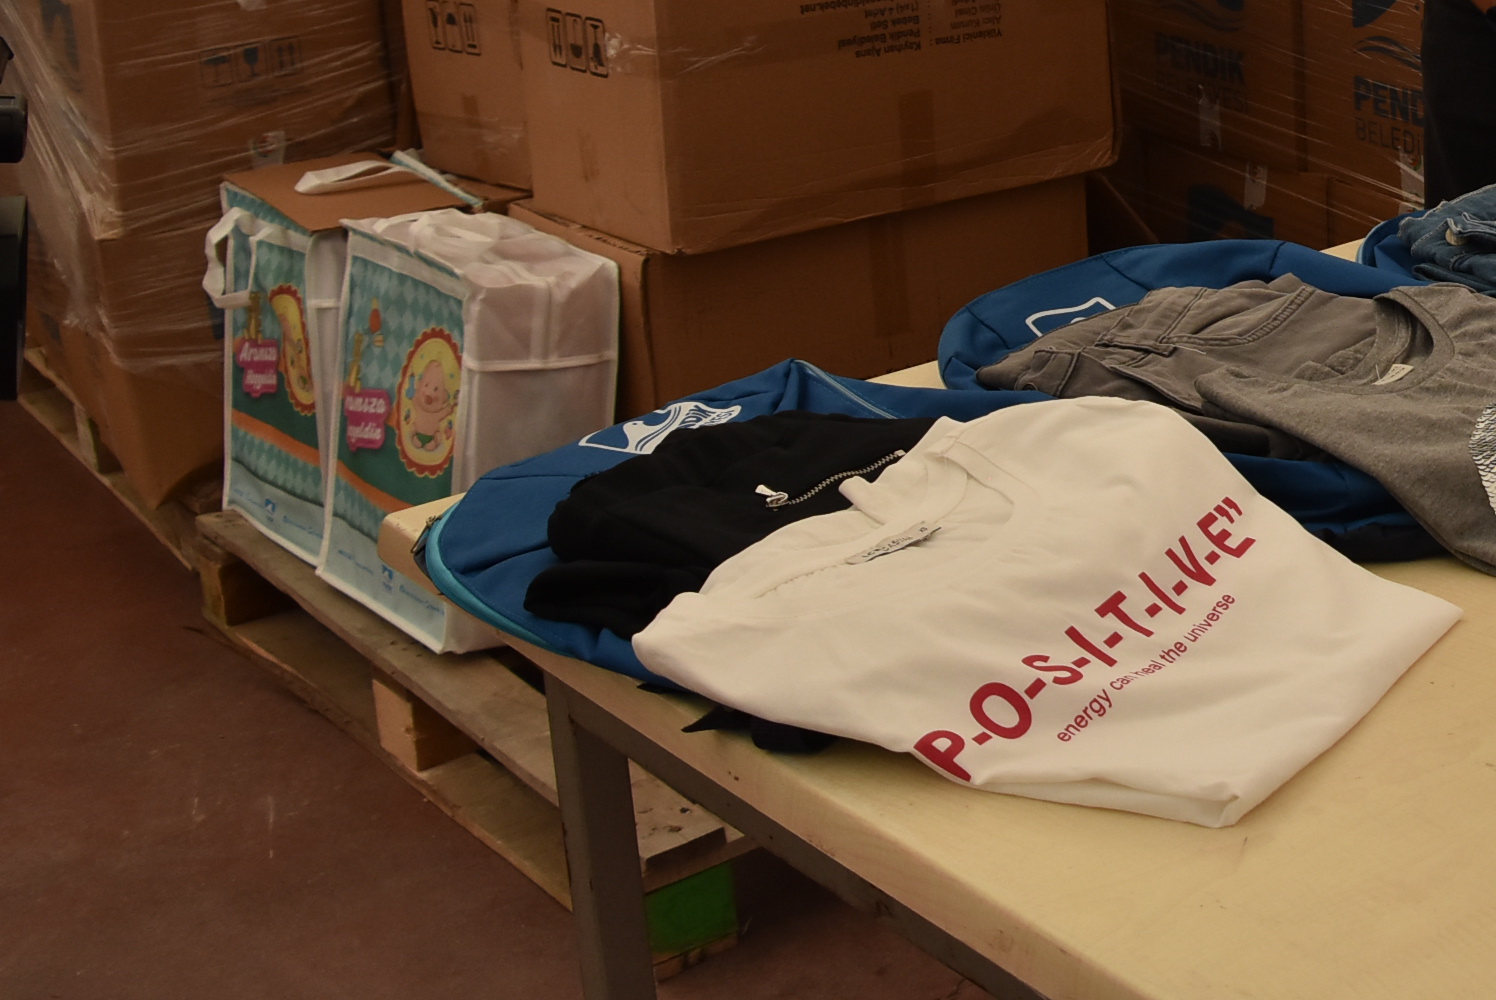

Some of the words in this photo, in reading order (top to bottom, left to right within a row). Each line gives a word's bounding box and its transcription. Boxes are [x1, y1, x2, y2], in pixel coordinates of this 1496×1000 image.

[1056, 688, 1113, 743] energy
[1158, 640, 1188, 665] the
[1183, 593, 1236, 644] universe
